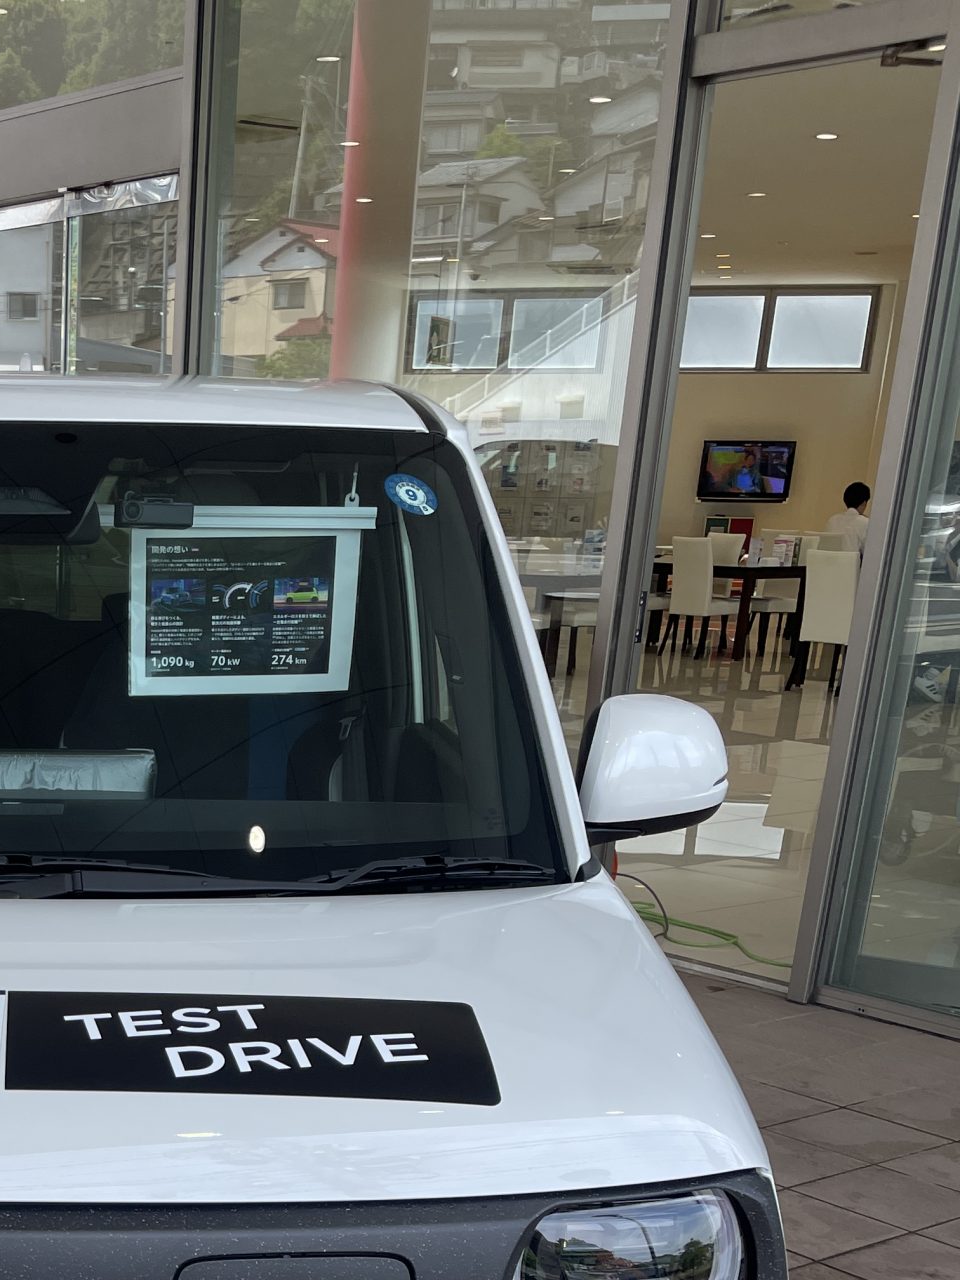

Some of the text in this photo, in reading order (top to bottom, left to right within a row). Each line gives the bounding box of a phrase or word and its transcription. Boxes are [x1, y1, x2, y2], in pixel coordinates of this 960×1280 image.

[405, 489, 417, 501] 9
[151, 656, 195, 668] 1,090 kg
[211, 655, 240, 666] 70 kW
[271, 654, 307, 665] 274 km
[63, 1003, 267, 1041] TEST
[164, 1032, 430, 1079] DRIVE
